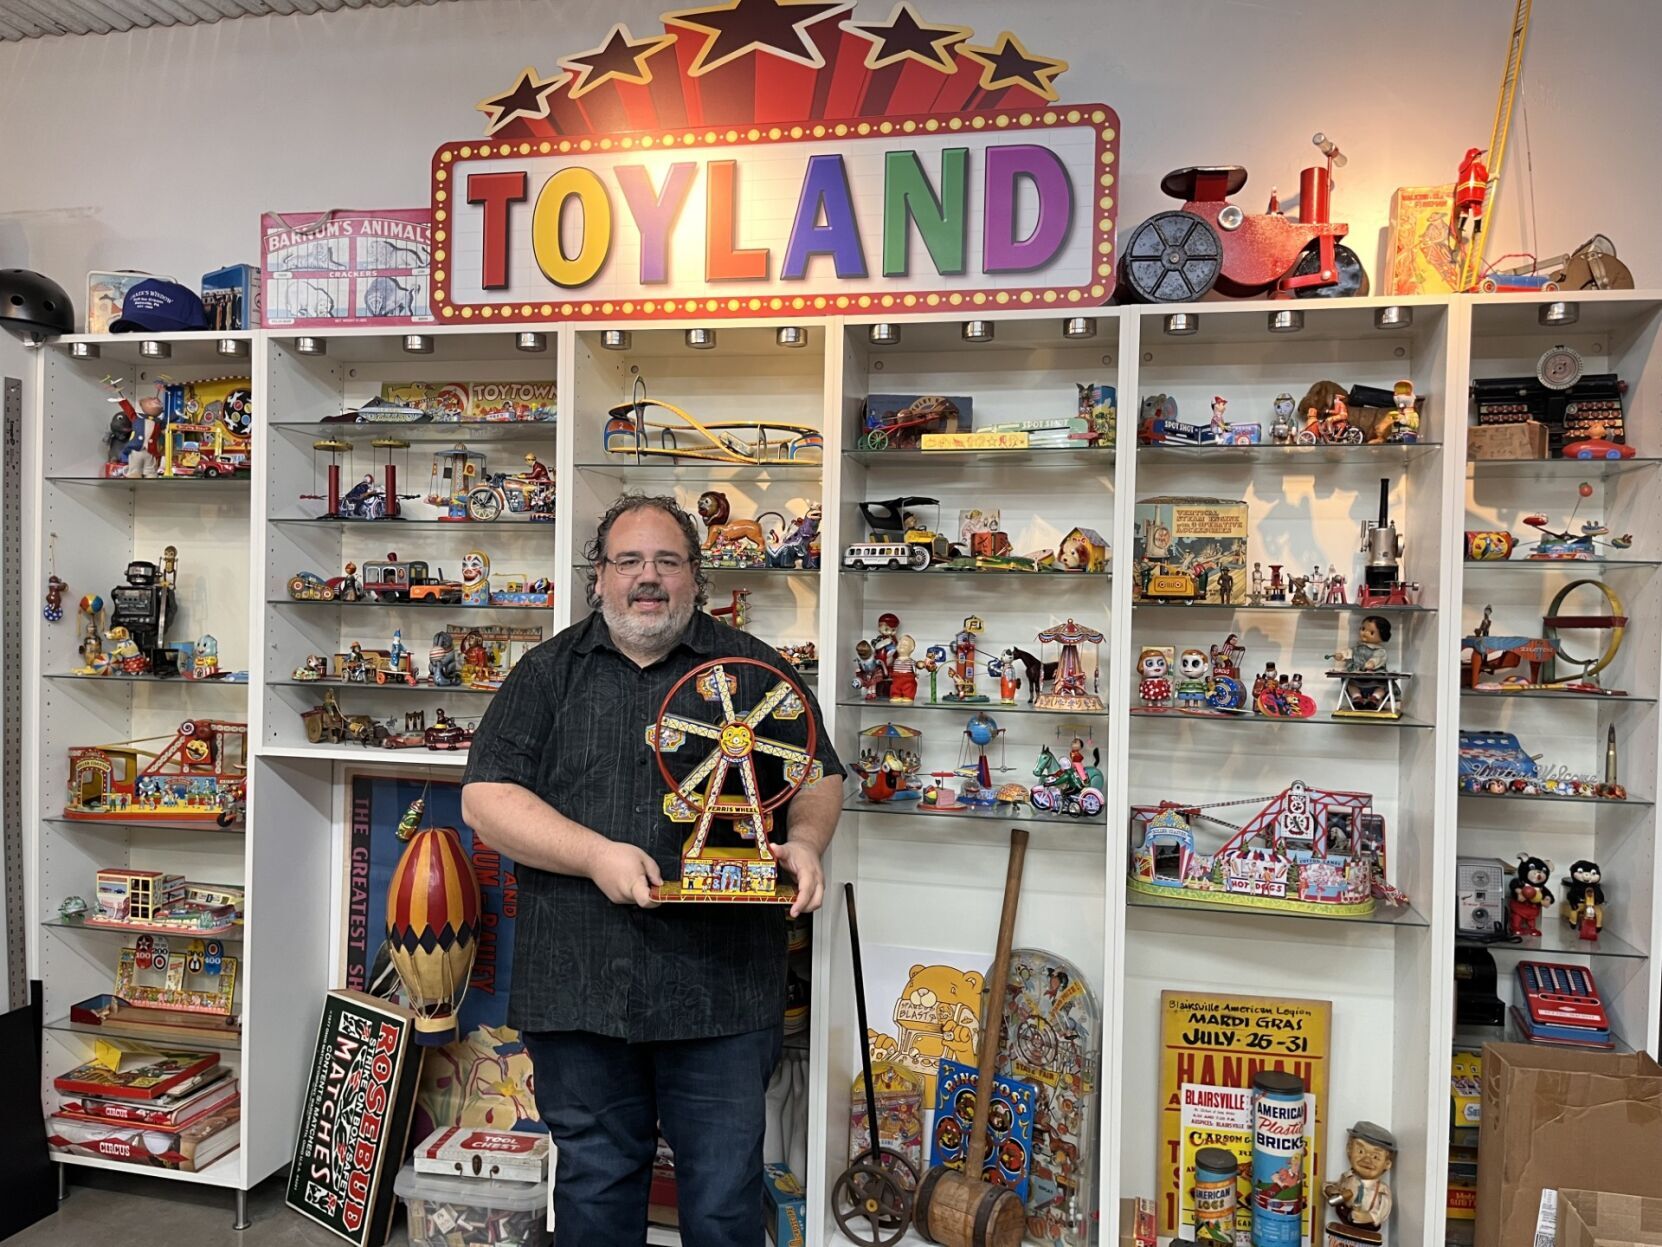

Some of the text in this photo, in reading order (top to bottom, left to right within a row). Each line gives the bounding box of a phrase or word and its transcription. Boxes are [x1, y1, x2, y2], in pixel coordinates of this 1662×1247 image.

[466, 143, 1076, 291] TOYLAND
[268, 220, 431, 251] BARNUM'S ANIMALS
[353, 799, 369, 836] THE
[1231, 880, 1248, 889] HOT
[350, 847, 369, 951] GREATEST
[502, 871, 518, 919] AND
[900, 1010, 930, 1020] BLAST
[1169, 999, 1312, 1018] Blairsville American Legion
[1188, 1013, 1303, 1031] MARDI GRAS
[361, 1037, 377, 1088] STRIKE
[315, 1045, 333, 1104] CONTENTS:
[1039, 1070, 1054, 1080] FAIR
[357, 1092, 367, 1114] ON
[1185, 1089, 1245, 1110] BLAIRSVILLE
[105, 1107, 128, 1119] CIRCUS
[311, 1036, 359, 1185] MATCHES
[304, 1107, 320, 1158] MATCHES
[342, 1021, 400, 1232] ROSEBUD
[99, 1141, 131, 1157] CIRCUS
[472, 1141, 520, 1150] CHEST
[485, 1135, 518, 1145] TOOL
[1189, 1131, 1242, 1147] CARSON
[1257, 1132, 1303, 1150] BRICKS
[1198, 1199, 1225, 1210] LOGS
